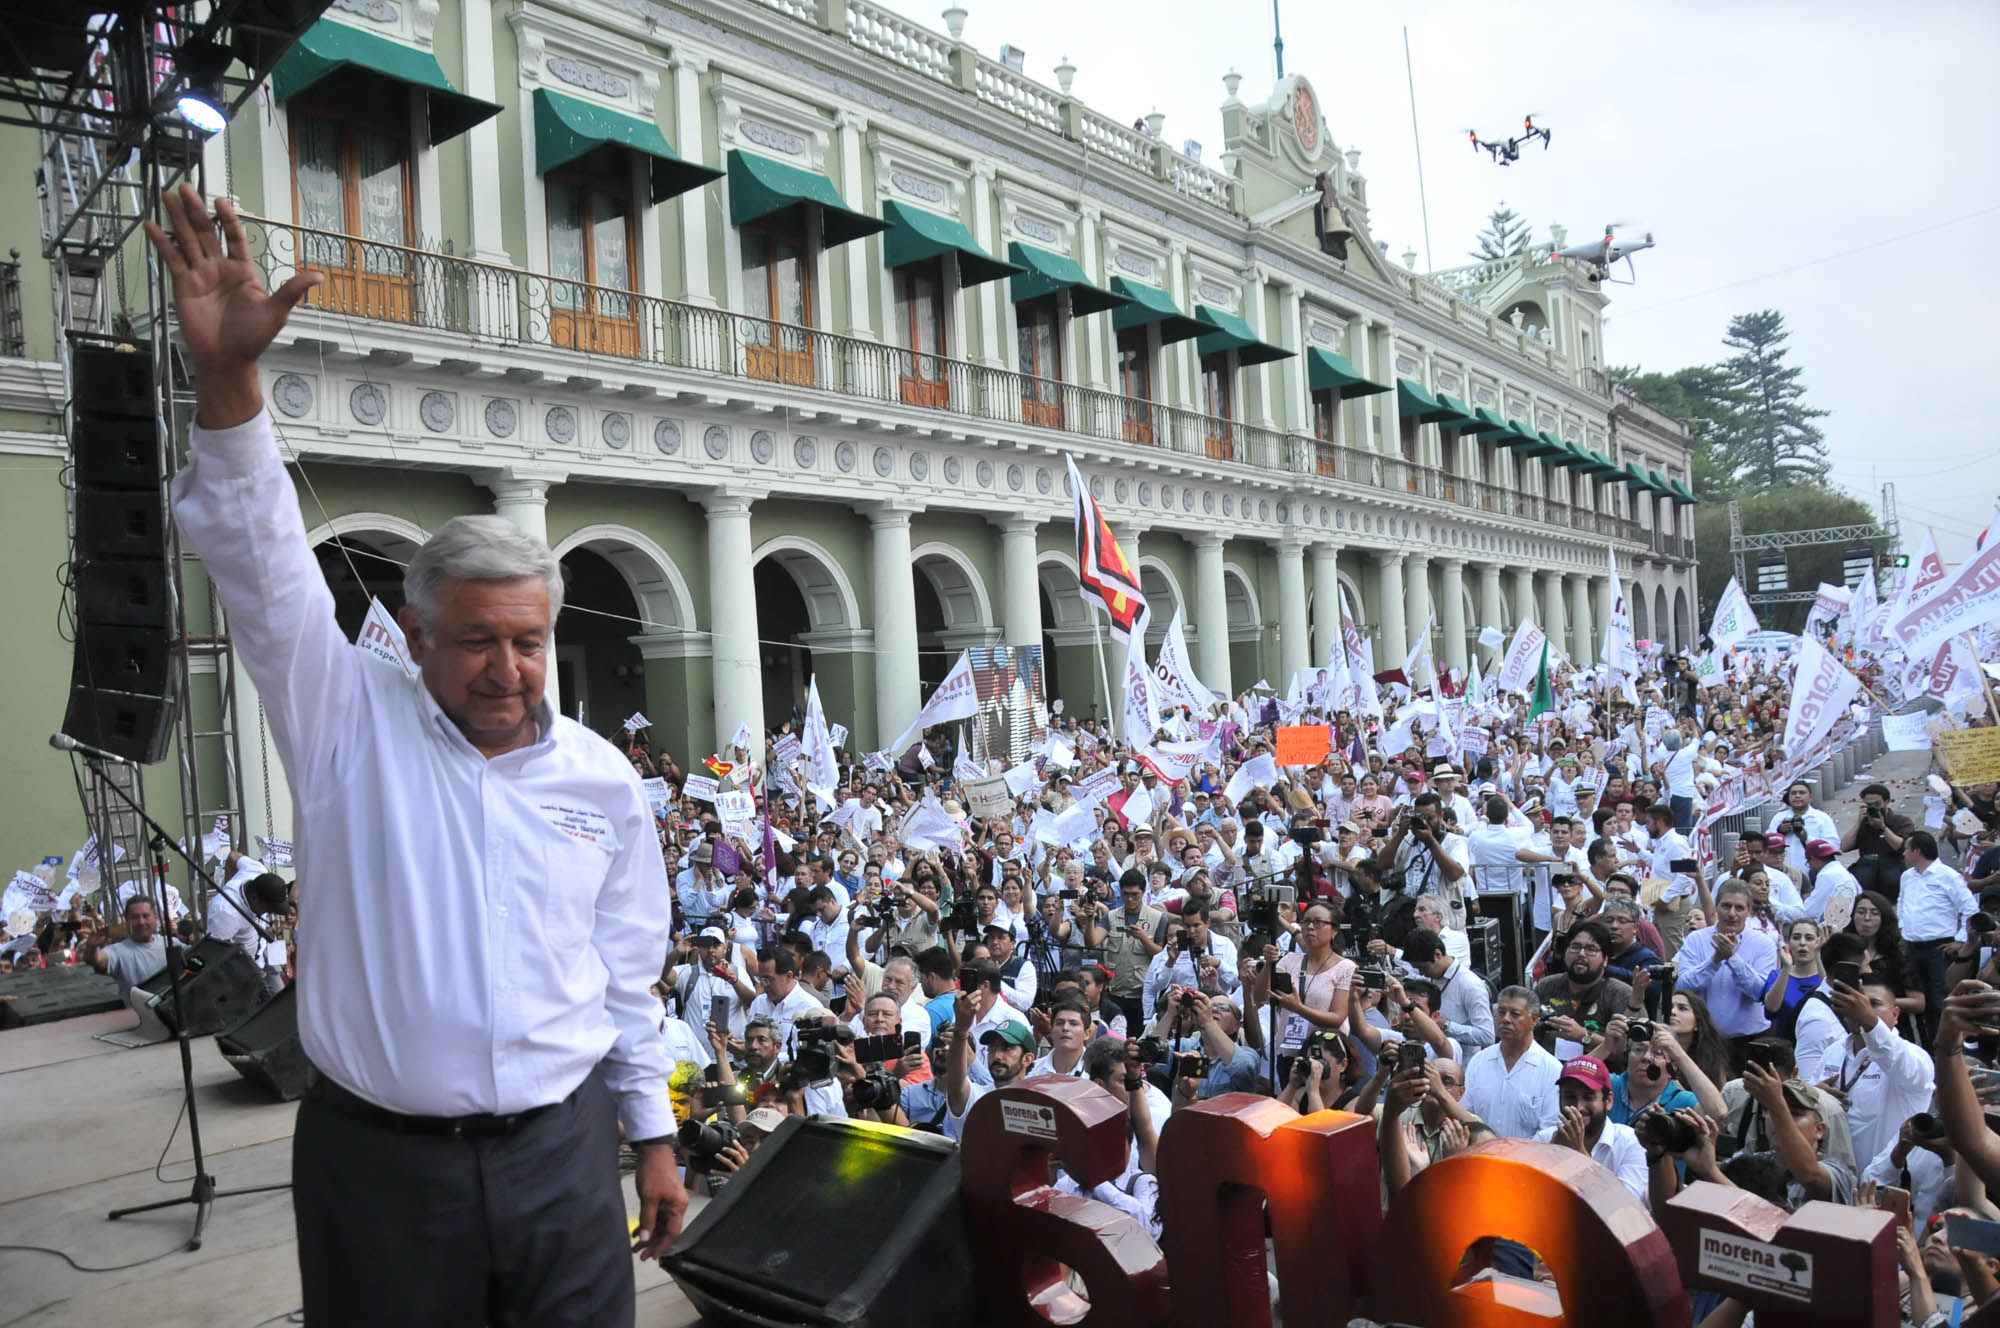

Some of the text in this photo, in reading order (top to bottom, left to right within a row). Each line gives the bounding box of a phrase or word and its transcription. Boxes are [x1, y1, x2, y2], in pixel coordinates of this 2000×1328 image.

[374, 647, 401, 665] esper
[1567, 1060, 1598, 1071] morena
[1003, 1105, 1039, 1121] morena
[1704, 1237, 1776, 1269] morena
